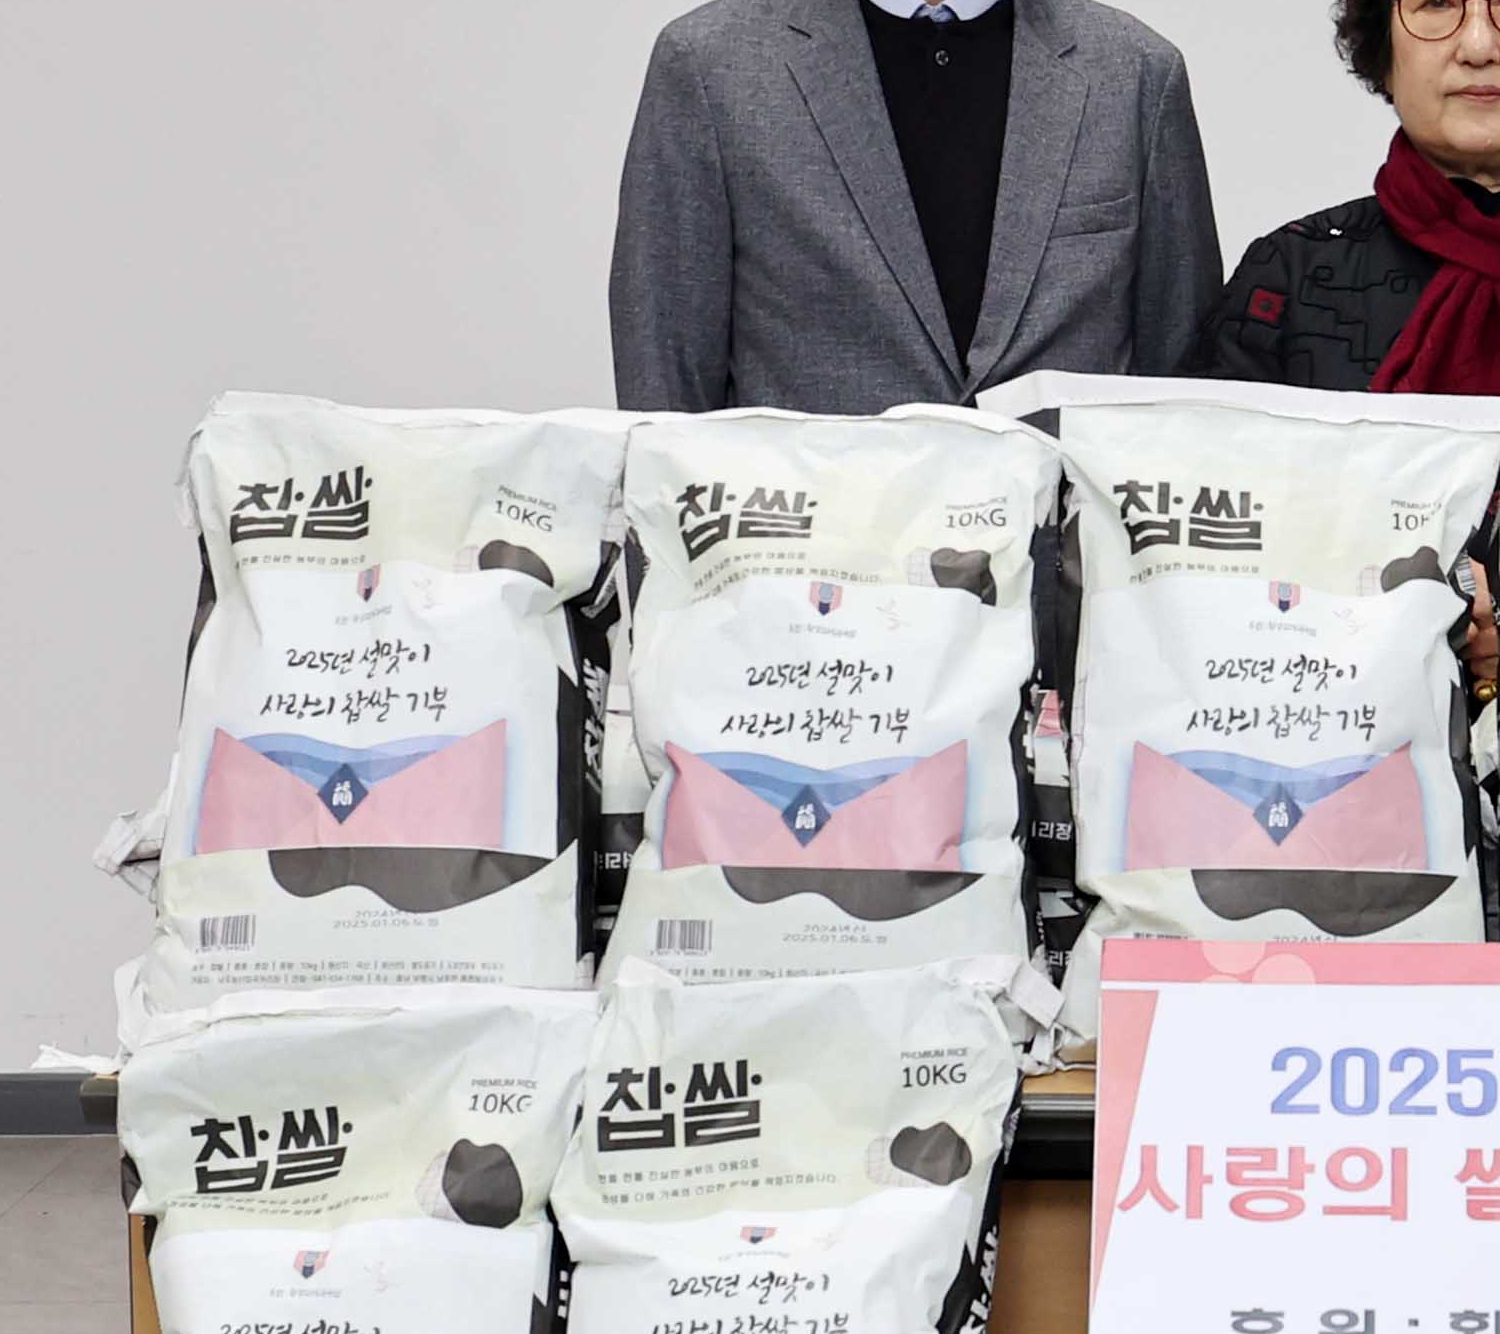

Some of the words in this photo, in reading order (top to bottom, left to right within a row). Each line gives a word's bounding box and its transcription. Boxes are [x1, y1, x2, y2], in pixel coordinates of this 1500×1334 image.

[228, 465, 373, 546] 찹쌀
[495, 496, 553, 532] 10KG
[675, 482, 818, 564] 찹쌀
[947, 507, 1007, 529] 10KG
[1112, 480, 1263, 556] 찹쌀
[286, 648, 355, 675] 2025년
[359, 639, 431, 679] 설맞이
[746, 661, 811, 690] 2025년
[816, 658, 893, 697] 설맞이
[1205, 658, 1275, 684] 2025년
[1281, 653, 1357, 694] 설맞이
[259, 693, 336, 720] 사랑의
[340, 686, 400, 725] 찹쌀
[406, 685, 448, 722] 기부
[1186, 706, 1260, 732] 사랑의
[1266, 703, 1331, 742] 찹쌀
[1336, 704, 1376, 742] 기부
[720, 712, 795, 739] 사랑의
[800, 707, 862, 744] 찹쌀
[869, 708, 910, 744] 기부
[902, 1062, 967, 1089] 10KG
[1270, 1046, 1498, 1118] 2025
[596, 1058, 763, 1153] 찹쌀
[190, 1105, 353, 1195] 찹쌀
[1116, 1144, 1409, 1223] 사랑의
[668, 1274, 741, 1298] 2025년
[747, 1270, 830, 1305] 설맞이
